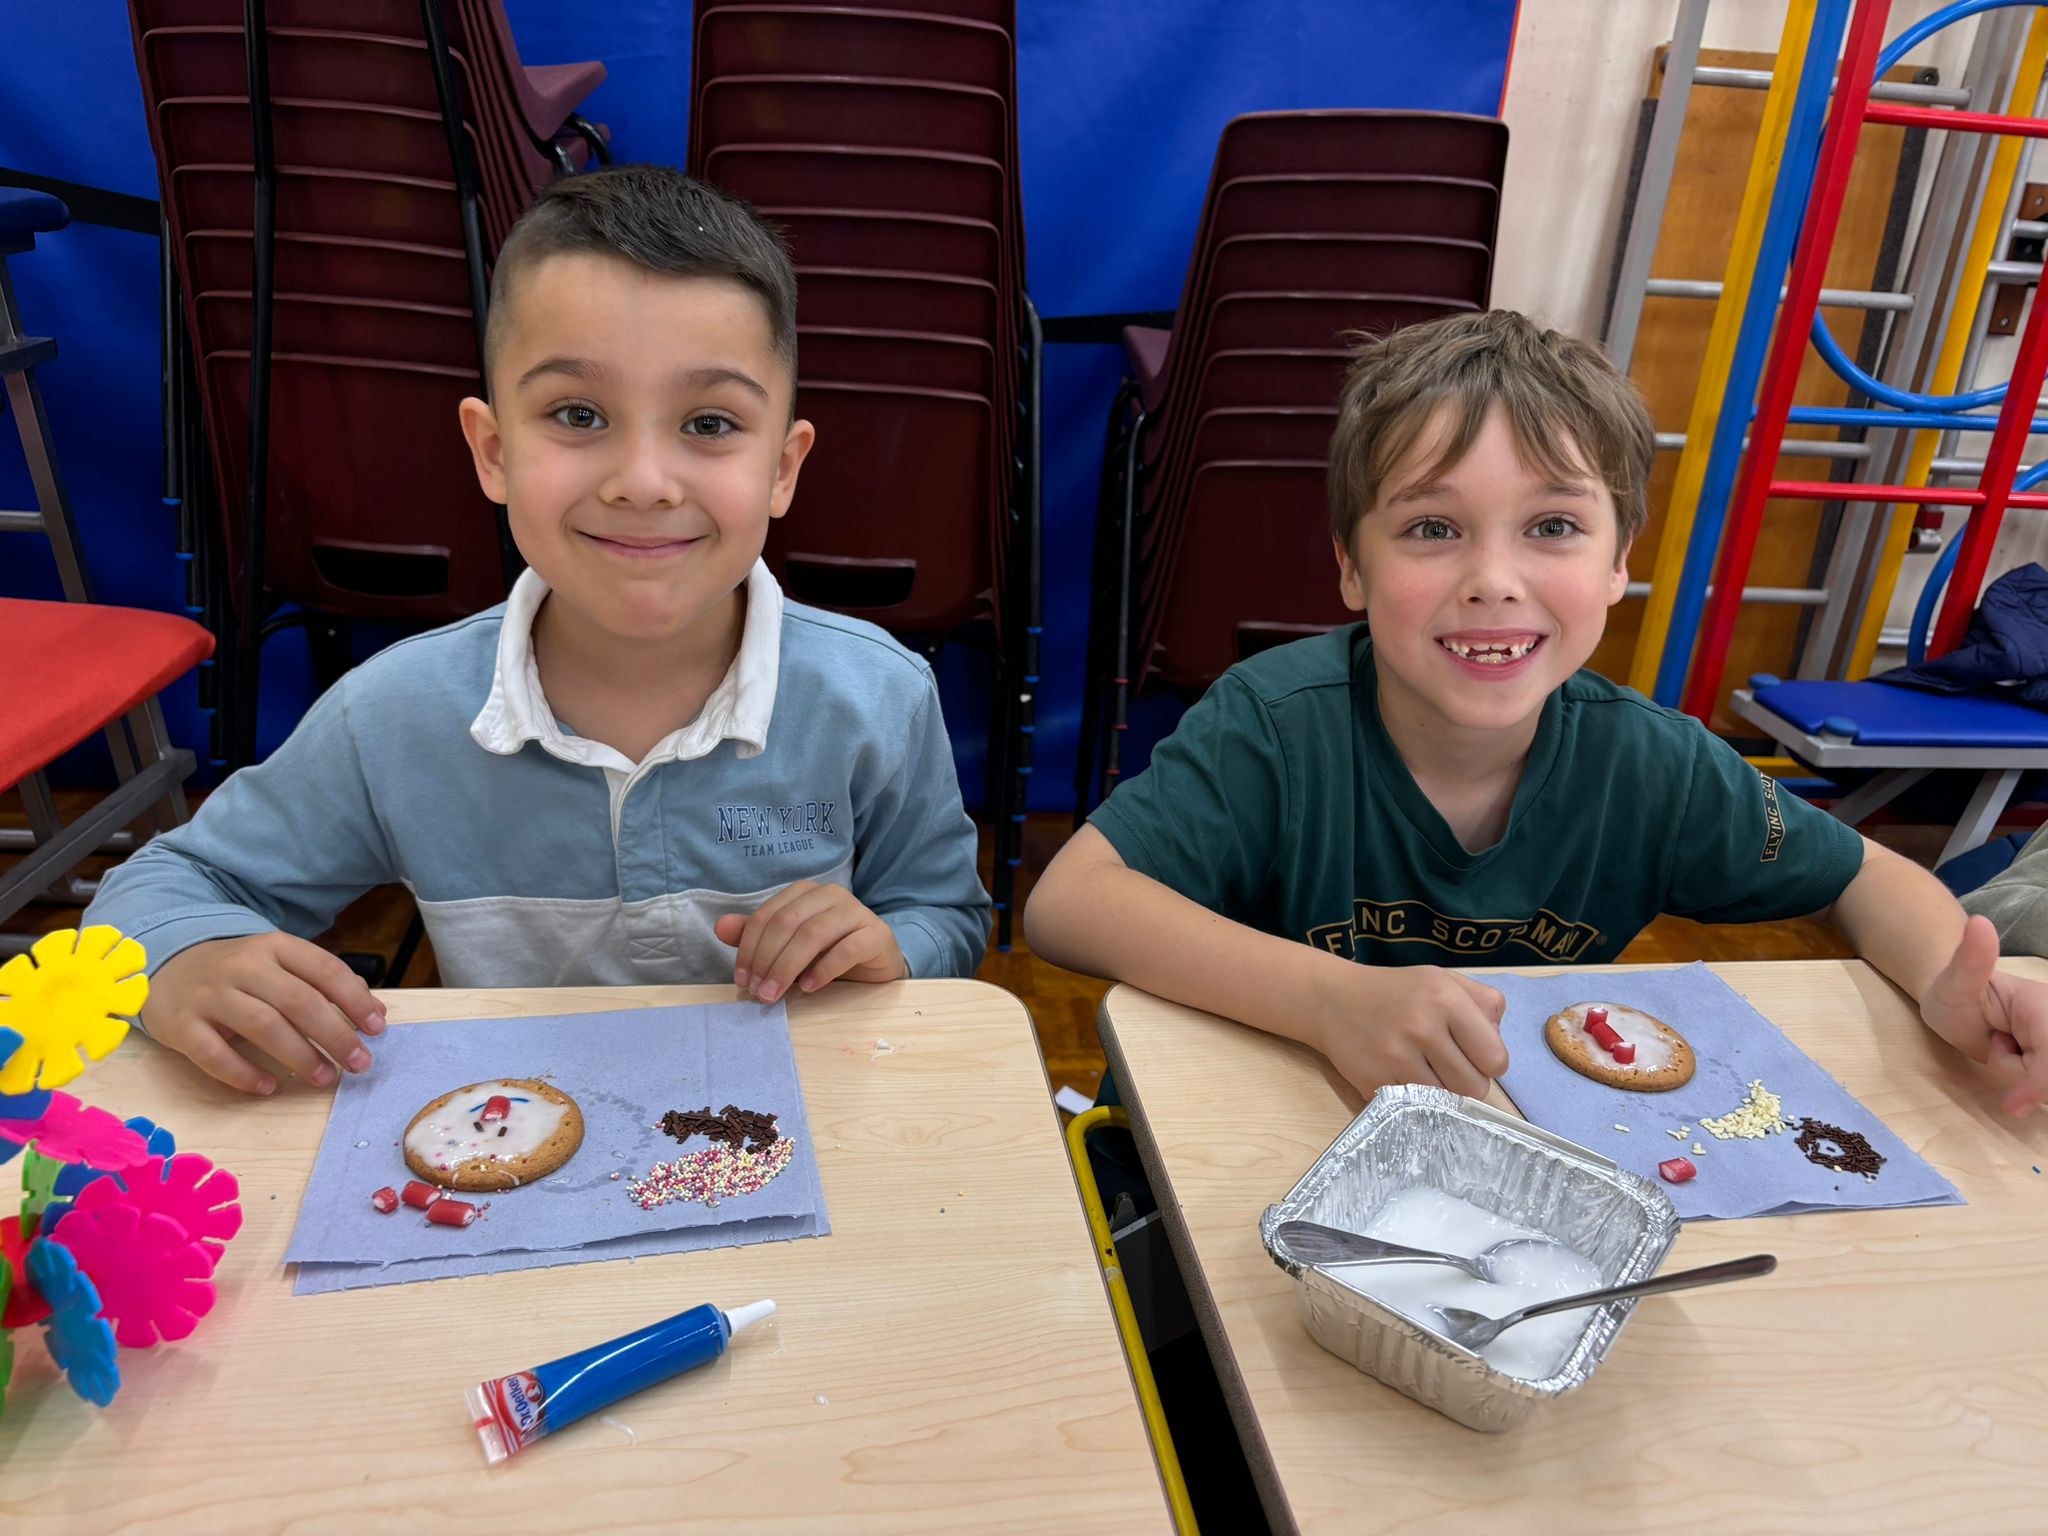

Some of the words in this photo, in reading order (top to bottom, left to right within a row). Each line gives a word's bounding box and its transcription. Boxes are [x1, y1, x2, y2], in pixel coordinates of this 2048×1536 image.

[717, 805, 772, 844] NEW
[778, 801, 836, 835] YORK
[743, 844, 774, 857] TEAM
[778, 839, 815, 855] LEAGUE
